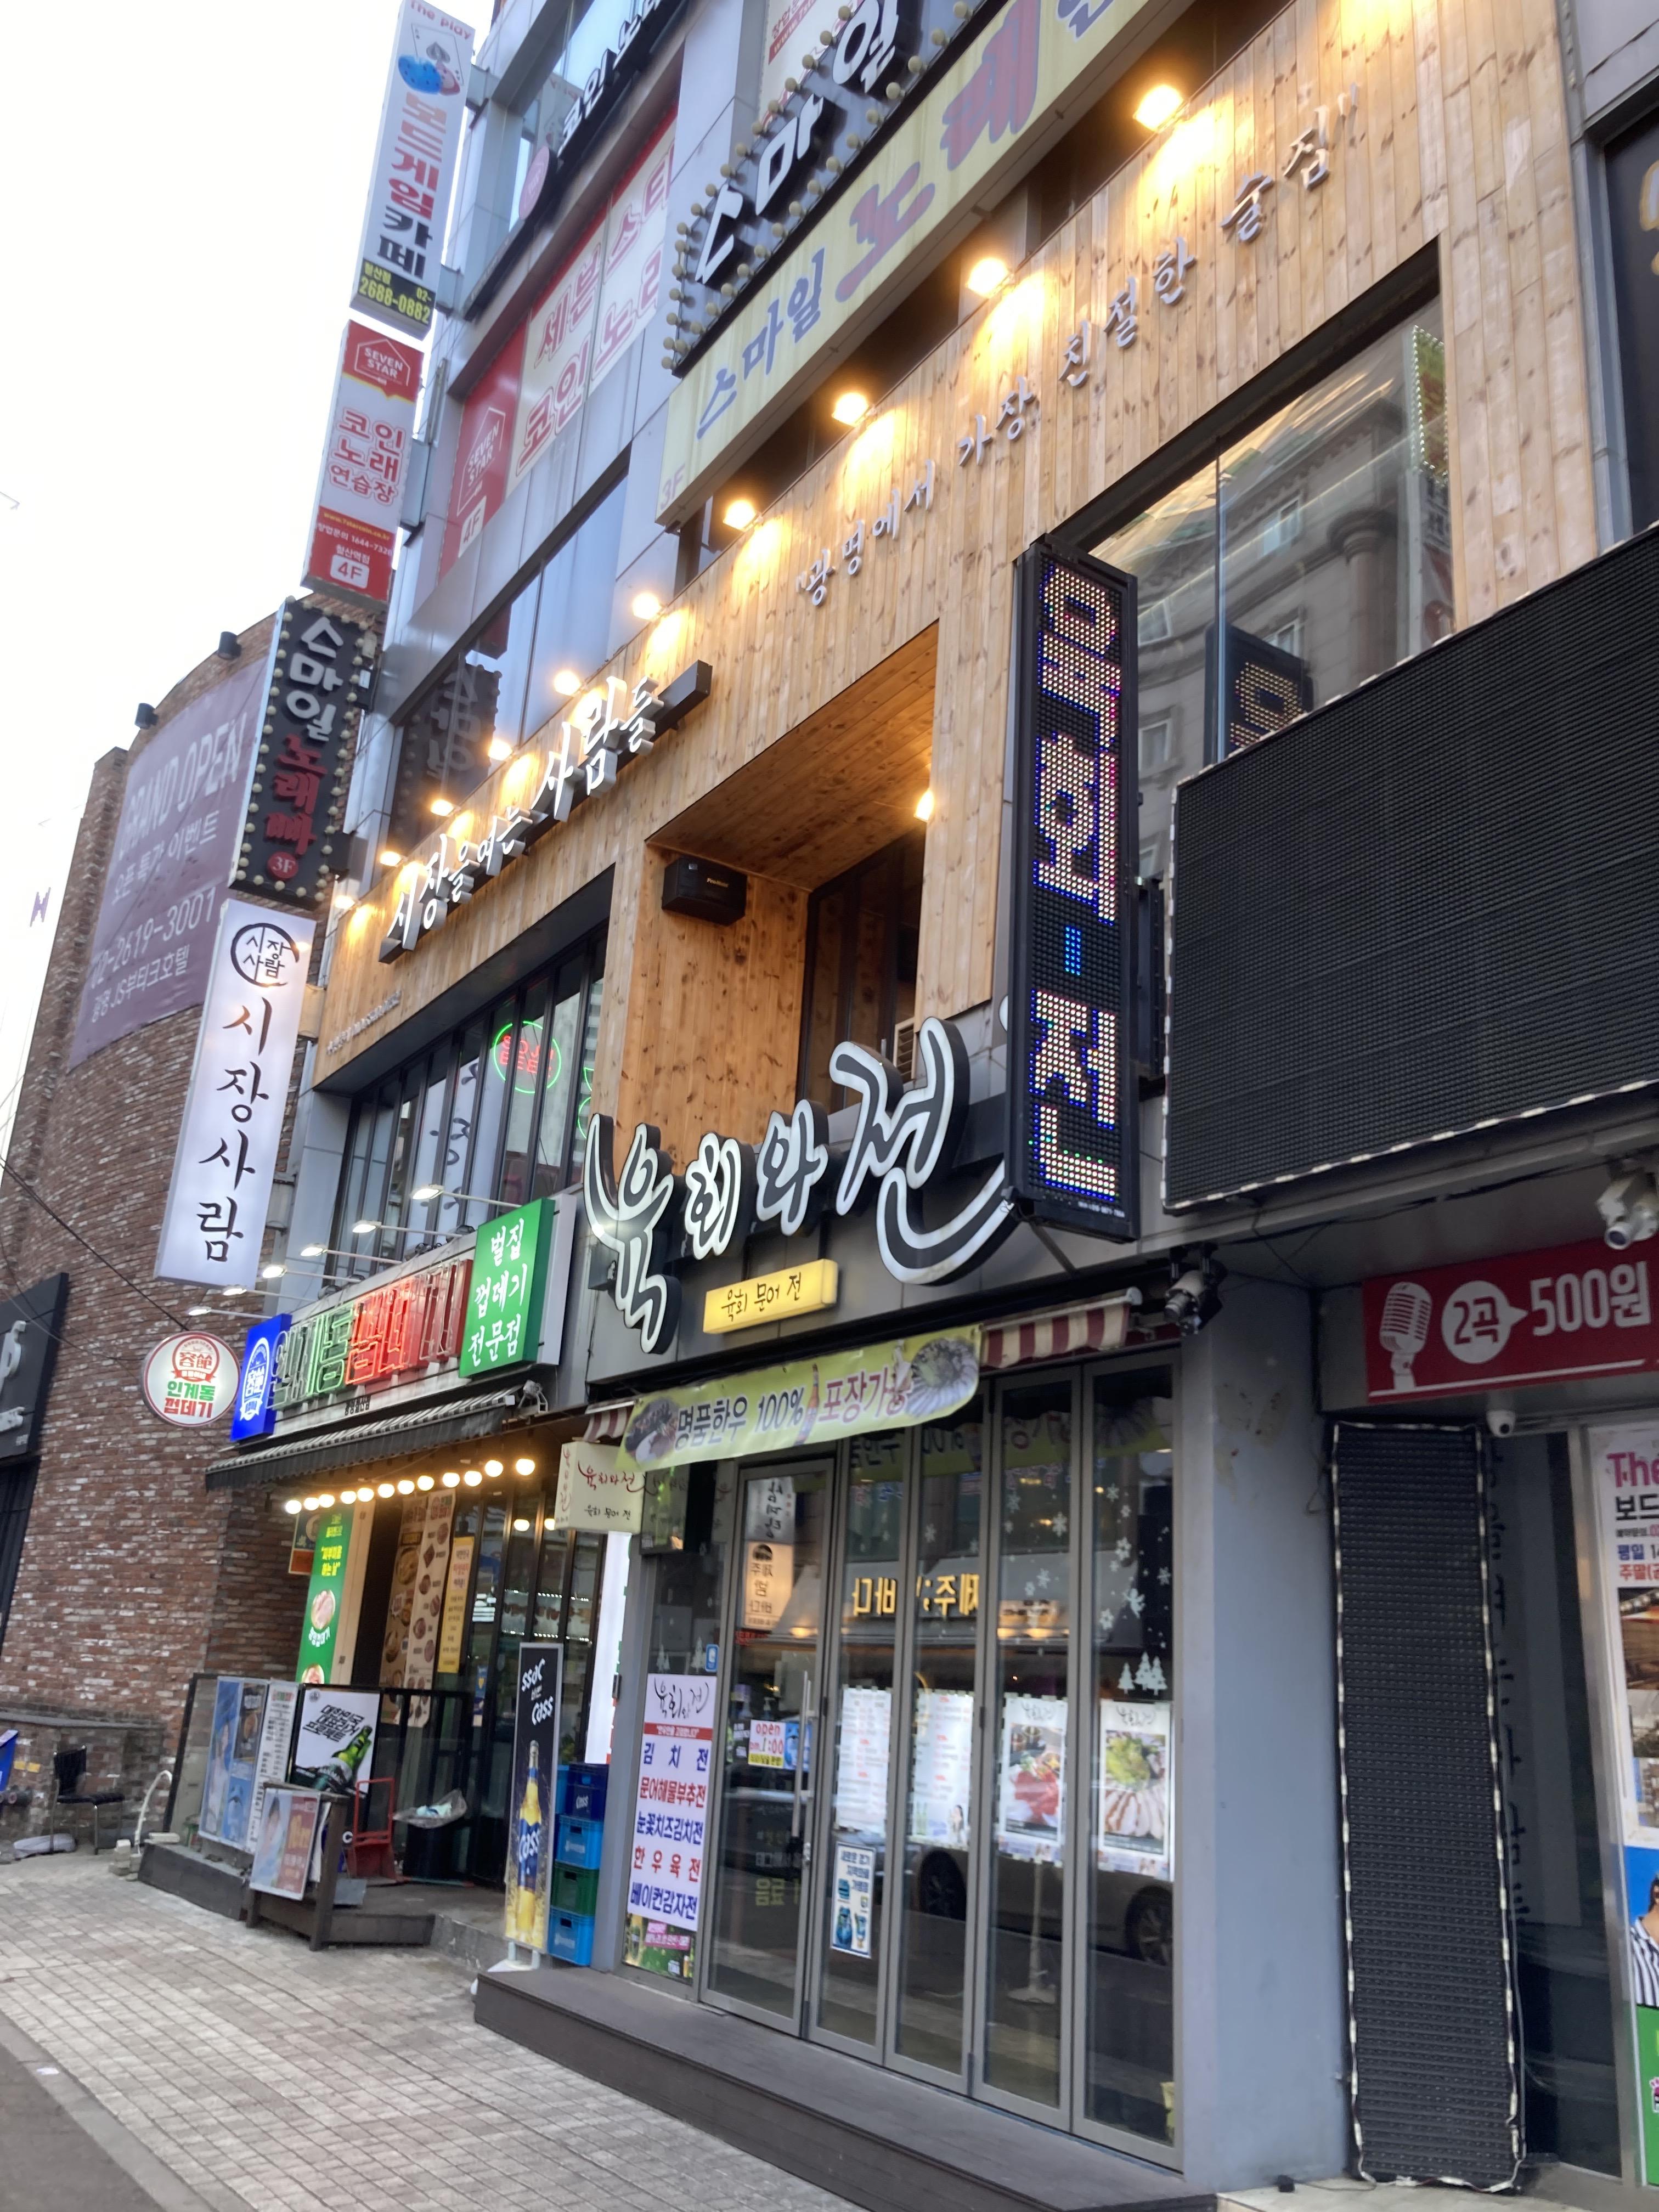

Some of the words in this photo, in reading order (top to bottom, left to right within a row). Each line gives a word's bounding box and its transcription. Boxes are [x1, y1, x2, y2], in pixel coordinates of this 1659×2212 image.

[359, 276, 431, 324] 2688-0882
[364, 347, 404, 371] SEVEN
[696, 248, 825, 440] 스마일
[958, 377, 1038, 467] 가장
[1059, 237, 1196, 388] 친절한
[367, 359, 398, 379] STAR
[338, 409, 404, 451] 코인
[468, 419, 500, 473] SEVEN
[330, 465, 396, 503] 연습장
[335, 439, 400, 484] 노래
[469, 444, 493, 487] STAR
[660, 463, 685, 511] 3F
[464, 508, 481, 544] 4F
[338, 562, 363, 579] 4F
[286, 616, 344, 742] 스마일
[178, 713, 248, 813] OPEN
[532, 675, 664, 822] 사람들
[169, 810, 219, 861] 이벤트
[272, 856, 296, 873] 3F
[91, 885, 217, 989] 02-2619-3001
[197, 996, 270, 1263] 시장사람
[490, 1217, 525, 1267] 벌집
[474, 1263, 528, 1319] 껍데기
[721, 1289, 748, 1321] 육회
[753, 1282, 781, 1310] 문어
[787, 1272, 803, 1301] 전
[1453, 1296, 1499, 1345] 2곡
[1530, 1261, 1651, 1336] 500원
[467, 1313, 521, 1367] 전문점
[163, 1397, 213, 1418] 껍데기
[167, 1380, 216, 1402] 인계동
[674, 1394, 747, 1451] 명품한우
[757, 1387, 805, 1436] 100%
[817, 1366, 909, 1424] 포장가능
[1617, 1544, 1645, 1561] 평일
[532, 1695, 554, 1726] Cass
[756, 1723, 781, 1737] open
[636, 1811, 704, 1846] 눈꽃치즈김치전
[630, 1881, 698, 1921] 베이컨감자전
